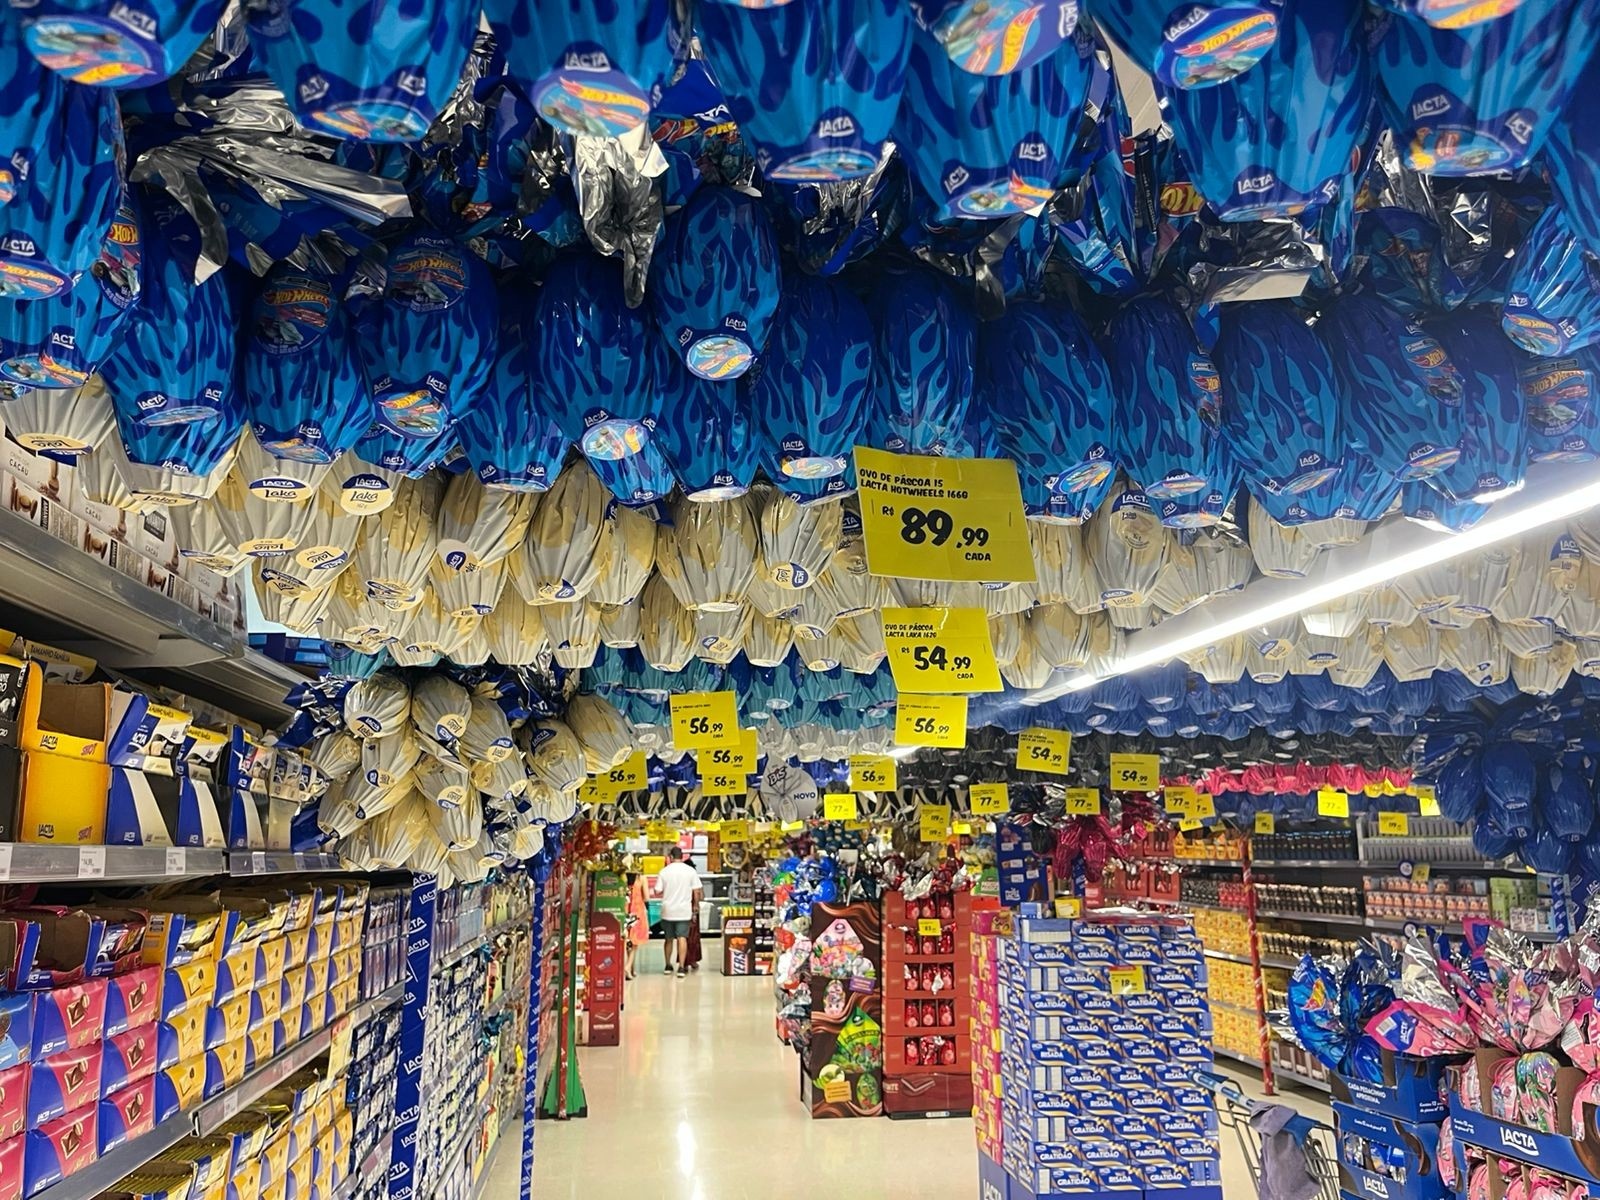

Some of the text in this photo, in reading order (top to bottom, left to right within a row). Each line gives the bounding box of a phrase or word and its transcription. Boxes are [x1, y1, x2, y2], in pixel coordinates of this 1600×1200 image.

[109, 4, 157, 40] LACTA
[1165, 6, 1209, 42] LACTA
[564, 51, 611, 72] LACTA
[1412, 94, 1450, 120] LACTA
[819, 115, 855, 138] LACTA
[1019, 142, 1047, 161] LACTA
[1237, 173, 1274, 194] LACTA
[407, 257, 465, 280] HOT WHEELS
[273, 290, 294, 303] HOT
[1533, 378, 1552, 395] HOT
[137, 394, 167, 410] LACTA
[782, 439, 804, 450] LACTA
[1409, 445, 1434, 459] LACTA
[1564, 440, 1586, 450] LACTA
[9, 458, 29, 477] CACAU
[162, 460, 189, 473] LACTA
[262, 479, 294, 487] LACTA
[355, 478, 382, 488] LACTA
[860, 468, 878, 480] OVO
[881, 473, 892, 483] DE
[894, 474, 931, 488] PÁSCOA
[1478, 476, 1501, 488] LACTA
[265, 489, 296, 500] Laka
[350, 490, 378, 503] Laka
[860, 479, 968, 500] LACTA HOTWHEELS 166G
[1121, 494, 1149, 504] LACT
[882, 506, 895, 517] R$
[965, 552, 992, 562] CADA
[909, 623, 934, 632] PÁSCOA
[40, 735, 58, 750] LACTA
[793, 791, 817, 800] NOVO
[39, 824, 54, 839] LACTA
[408, 938, 430, 956] ACTA
[1500, 1127, 1539, 1156] LACTA
[1363, 1176, 1389, 1199] LACTA
